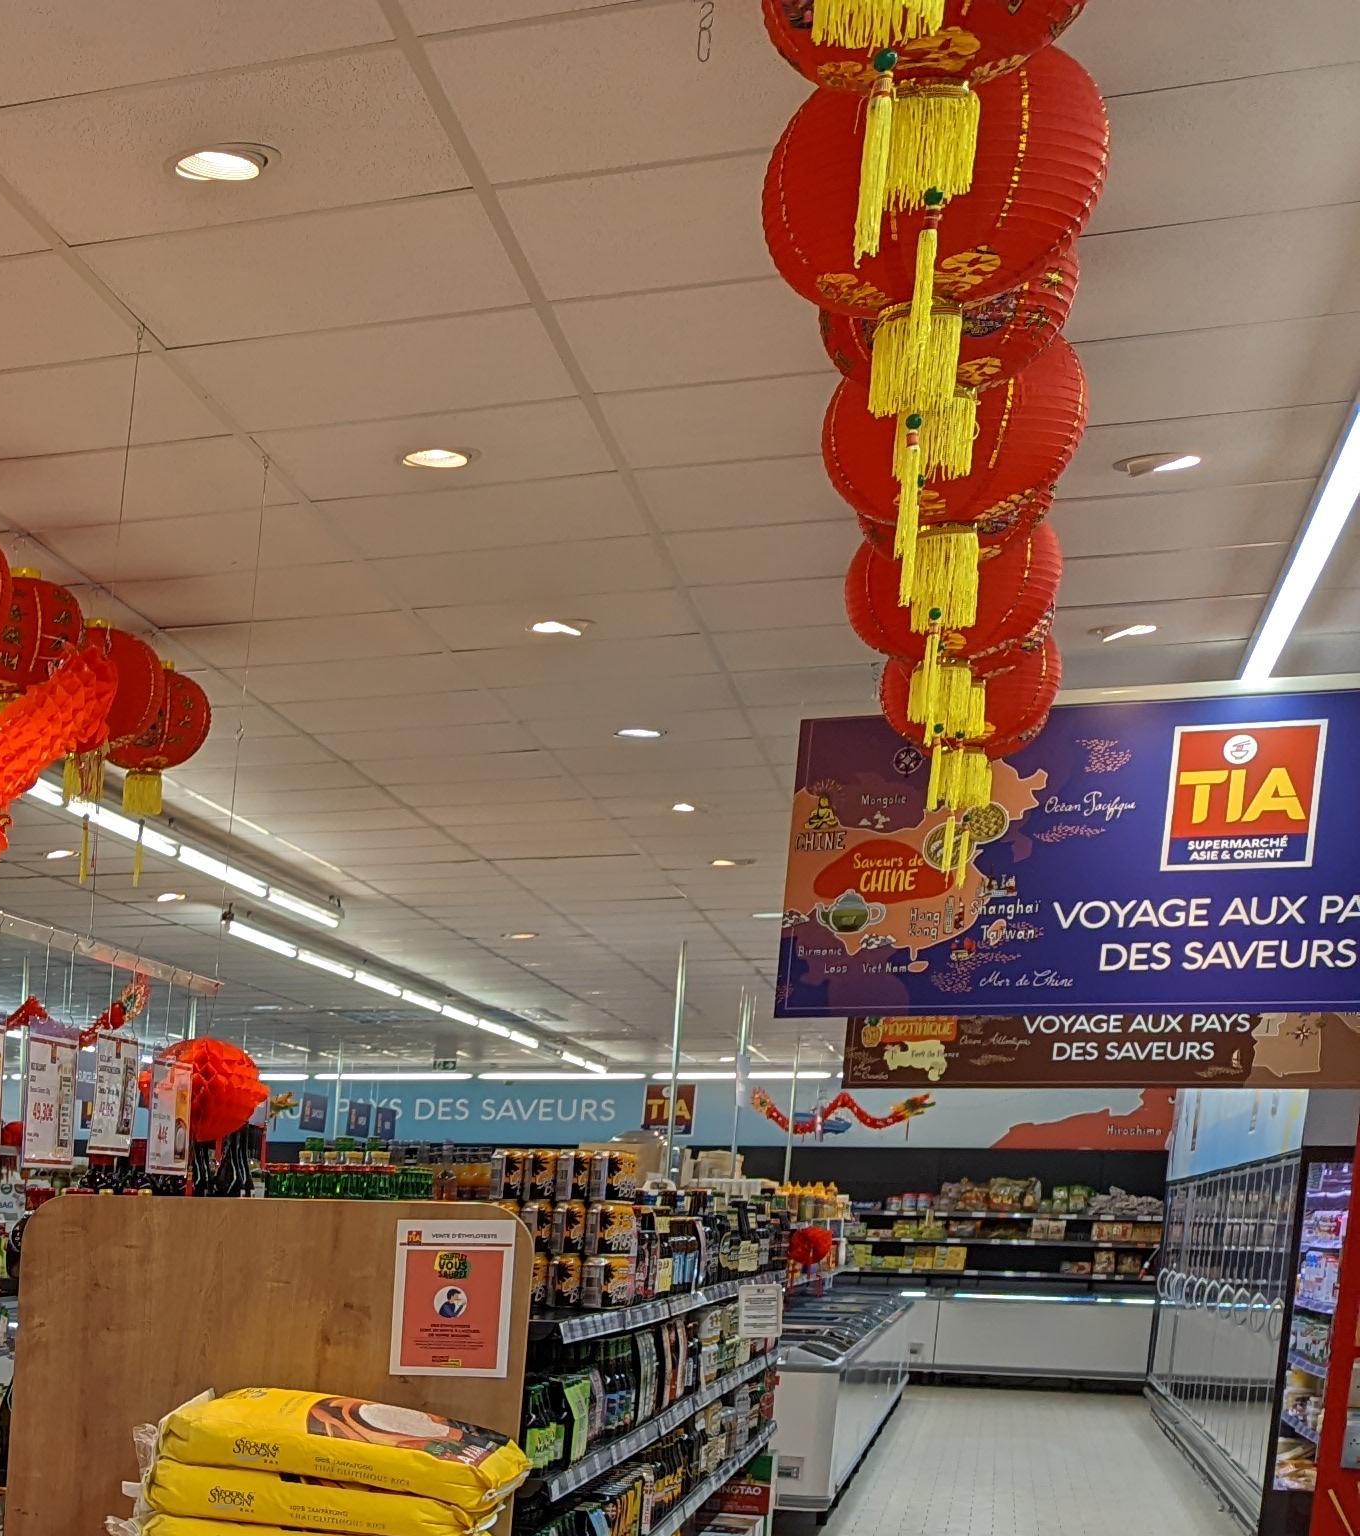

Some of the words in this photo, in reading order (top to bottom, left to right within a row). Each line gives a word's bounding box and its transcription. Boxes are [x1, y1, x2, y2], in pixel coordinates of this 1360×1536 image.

[861, 795, 907, 805] Mongolie
[1180, 767, 1306, 824] TIA
[795, 831, 847, 850] CHINE
[1188, 835, 1288, 850] SUPERMARCHÉ
[854, 853, 903, 868] Saveurs
[908, 853, 923, 866] de
[1189, 849, 1219, 862] ASIE
[1221, 849, 1231, 860] &
[1233, 848, 1283, 860] ORIENT
[860, 869, 918, 892] CHINE
[911, 908, 941, 925] Hong
[970, 900, 1041, 921] Shanghaï
[1053, 897, 1211, 930] VOYAGE
[1219, 896, 1308, 927] AUX
[908, 924, 938, 941] Kong
[1098, 942, 1174, 971] DES
[1182, 938, 1357, 970] SAVEURS
[885, 964, 907, 973] Nam
[1023, 1014, 1122, 1034] VOYAGE
[1128, 1014, 1184, 1034] AUX
[1190, 1013, 1250, 1033] PAYS
[1052, 1042, 1099, 1061] DES
[1106, 1041, 1215, 1061] SAVEURS
[415, 1098, 468, 1120] DES
[481, 1099, 616, 1122] SAVEURS
[438, 1261, 467, 1270] VOUS
